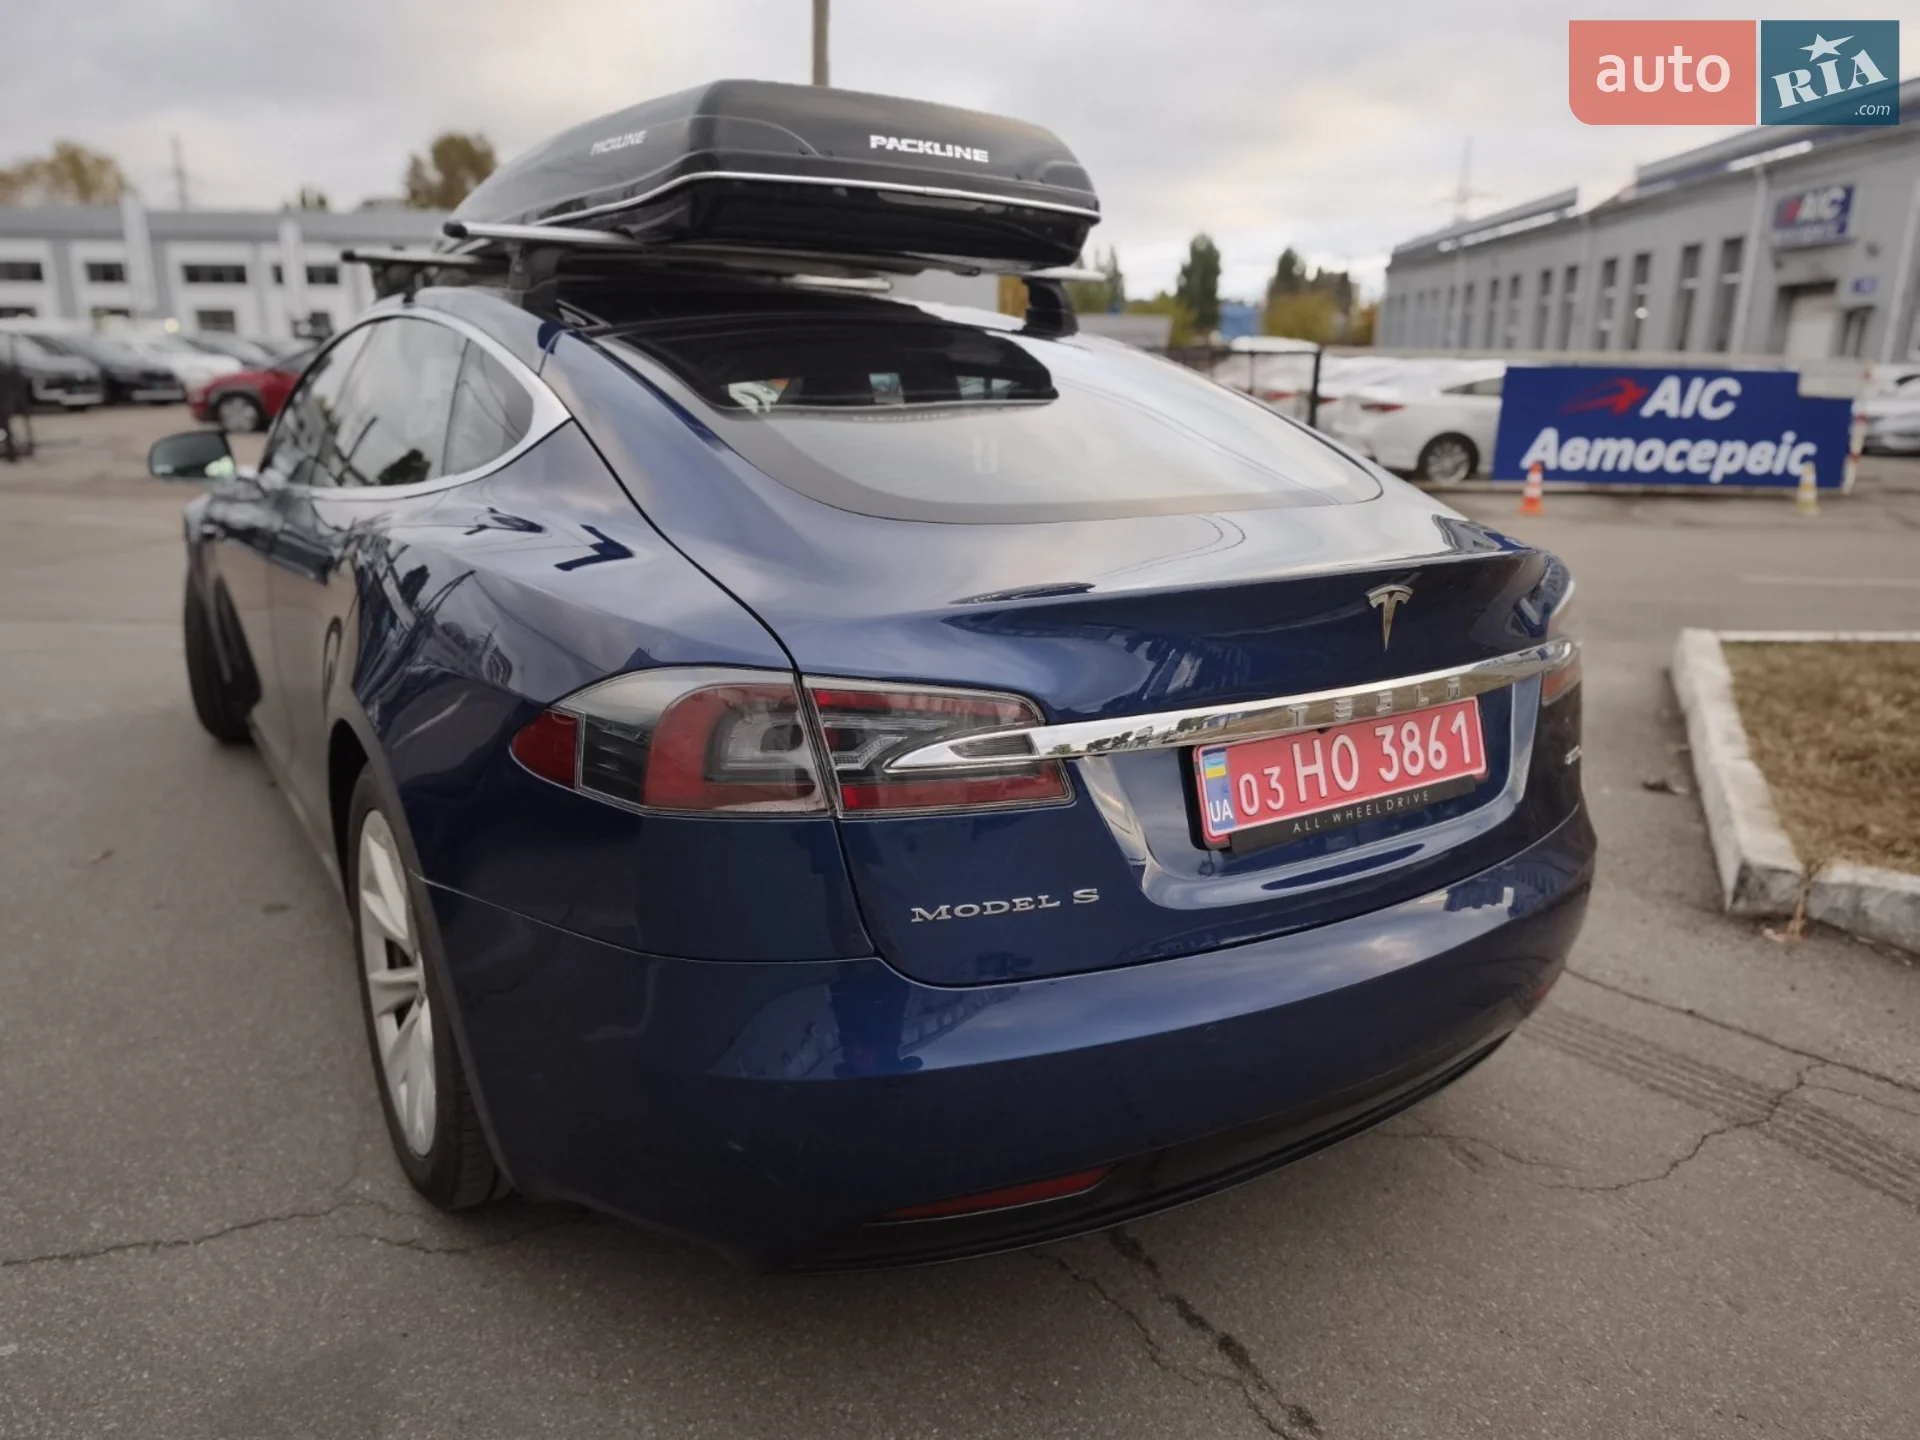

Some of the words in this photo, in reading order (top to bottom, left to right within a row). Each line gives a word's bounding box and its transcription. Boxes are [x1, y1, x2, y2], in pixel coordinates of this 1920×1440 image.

[869, 134, 989, 163] PACKLINE
[1520, 427, 1817, 484] Автосервіс
[1287, 675, 1461, 727] TESLA
[1238, 766, 1285, 816] 03
[1374, 710, 1472, 783] 3861
[1209, 799, 1234, 823] UA
[910, 895, 1061, 923] MODEL
[1072, 888, 1100, 905] S
